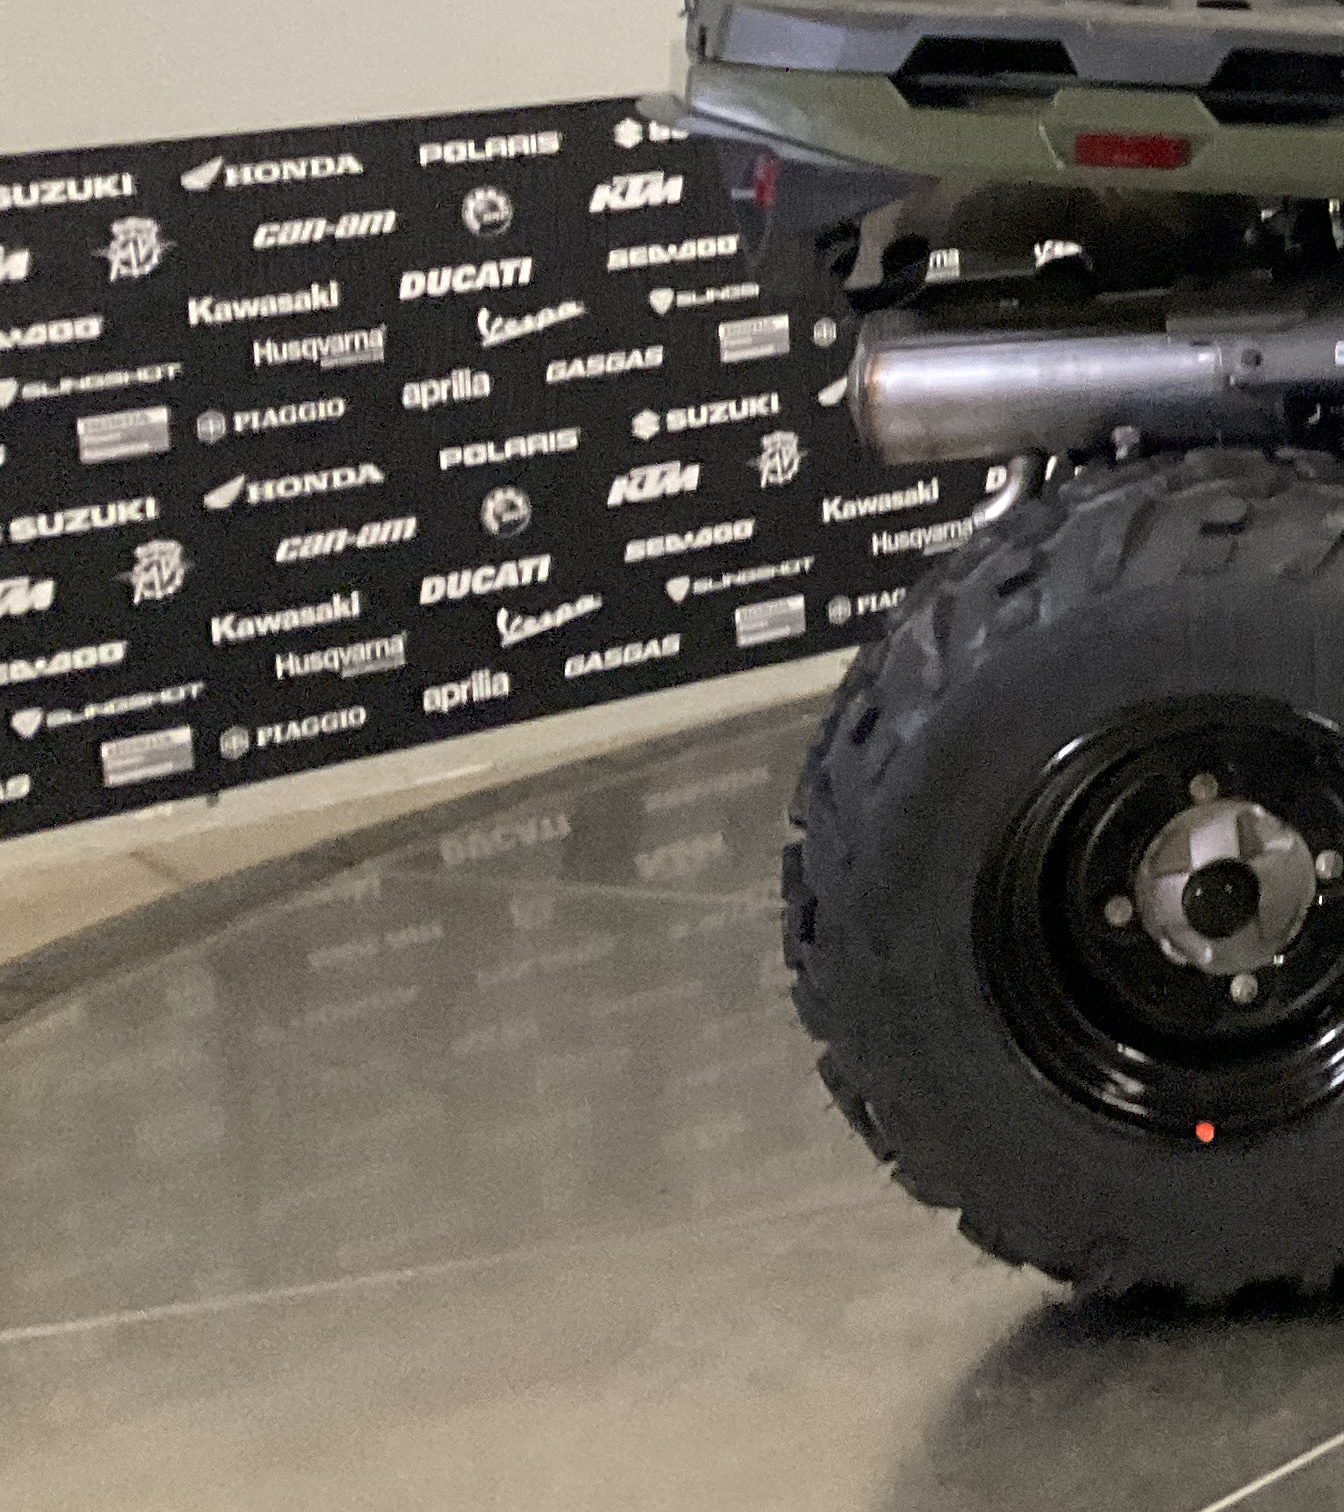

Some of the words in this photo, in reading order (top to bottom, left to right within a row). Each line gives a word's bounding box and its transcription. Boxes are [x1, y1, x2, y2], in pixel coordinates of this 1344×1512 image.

[419, 131, 562, 166] POLARIS
[225, 154, 363, 187] HONDA
[589, 172, 683, 213] KTM
[399, 257, 532, 300] DUCATI
[188, 281, 339, 325] Kawasaki
[546, 346, 663, 383] GASGAS
[402, 368, 491, 410] aprilia
[233, 398, 345, 432] PIAGGIO
[666, 393, 781, 434] SUZUKI
[440, 428, 580, 470] POLARIS
[247, 464, 384, 504] HONDA
[607, 461, 700, 506] KTM
[823, 478, 939, 523] Kawasaki
[9, 497, 160, 546] SUZUKI
[420, 554, 551, 604] DUCATI
[211, 591, 363, 648] Kawasaki
[565, 634, 680, 678] GASGAS
[423, 669, 510, 713] aprilia
[257, 706, 366, 747] PIAGGIO
